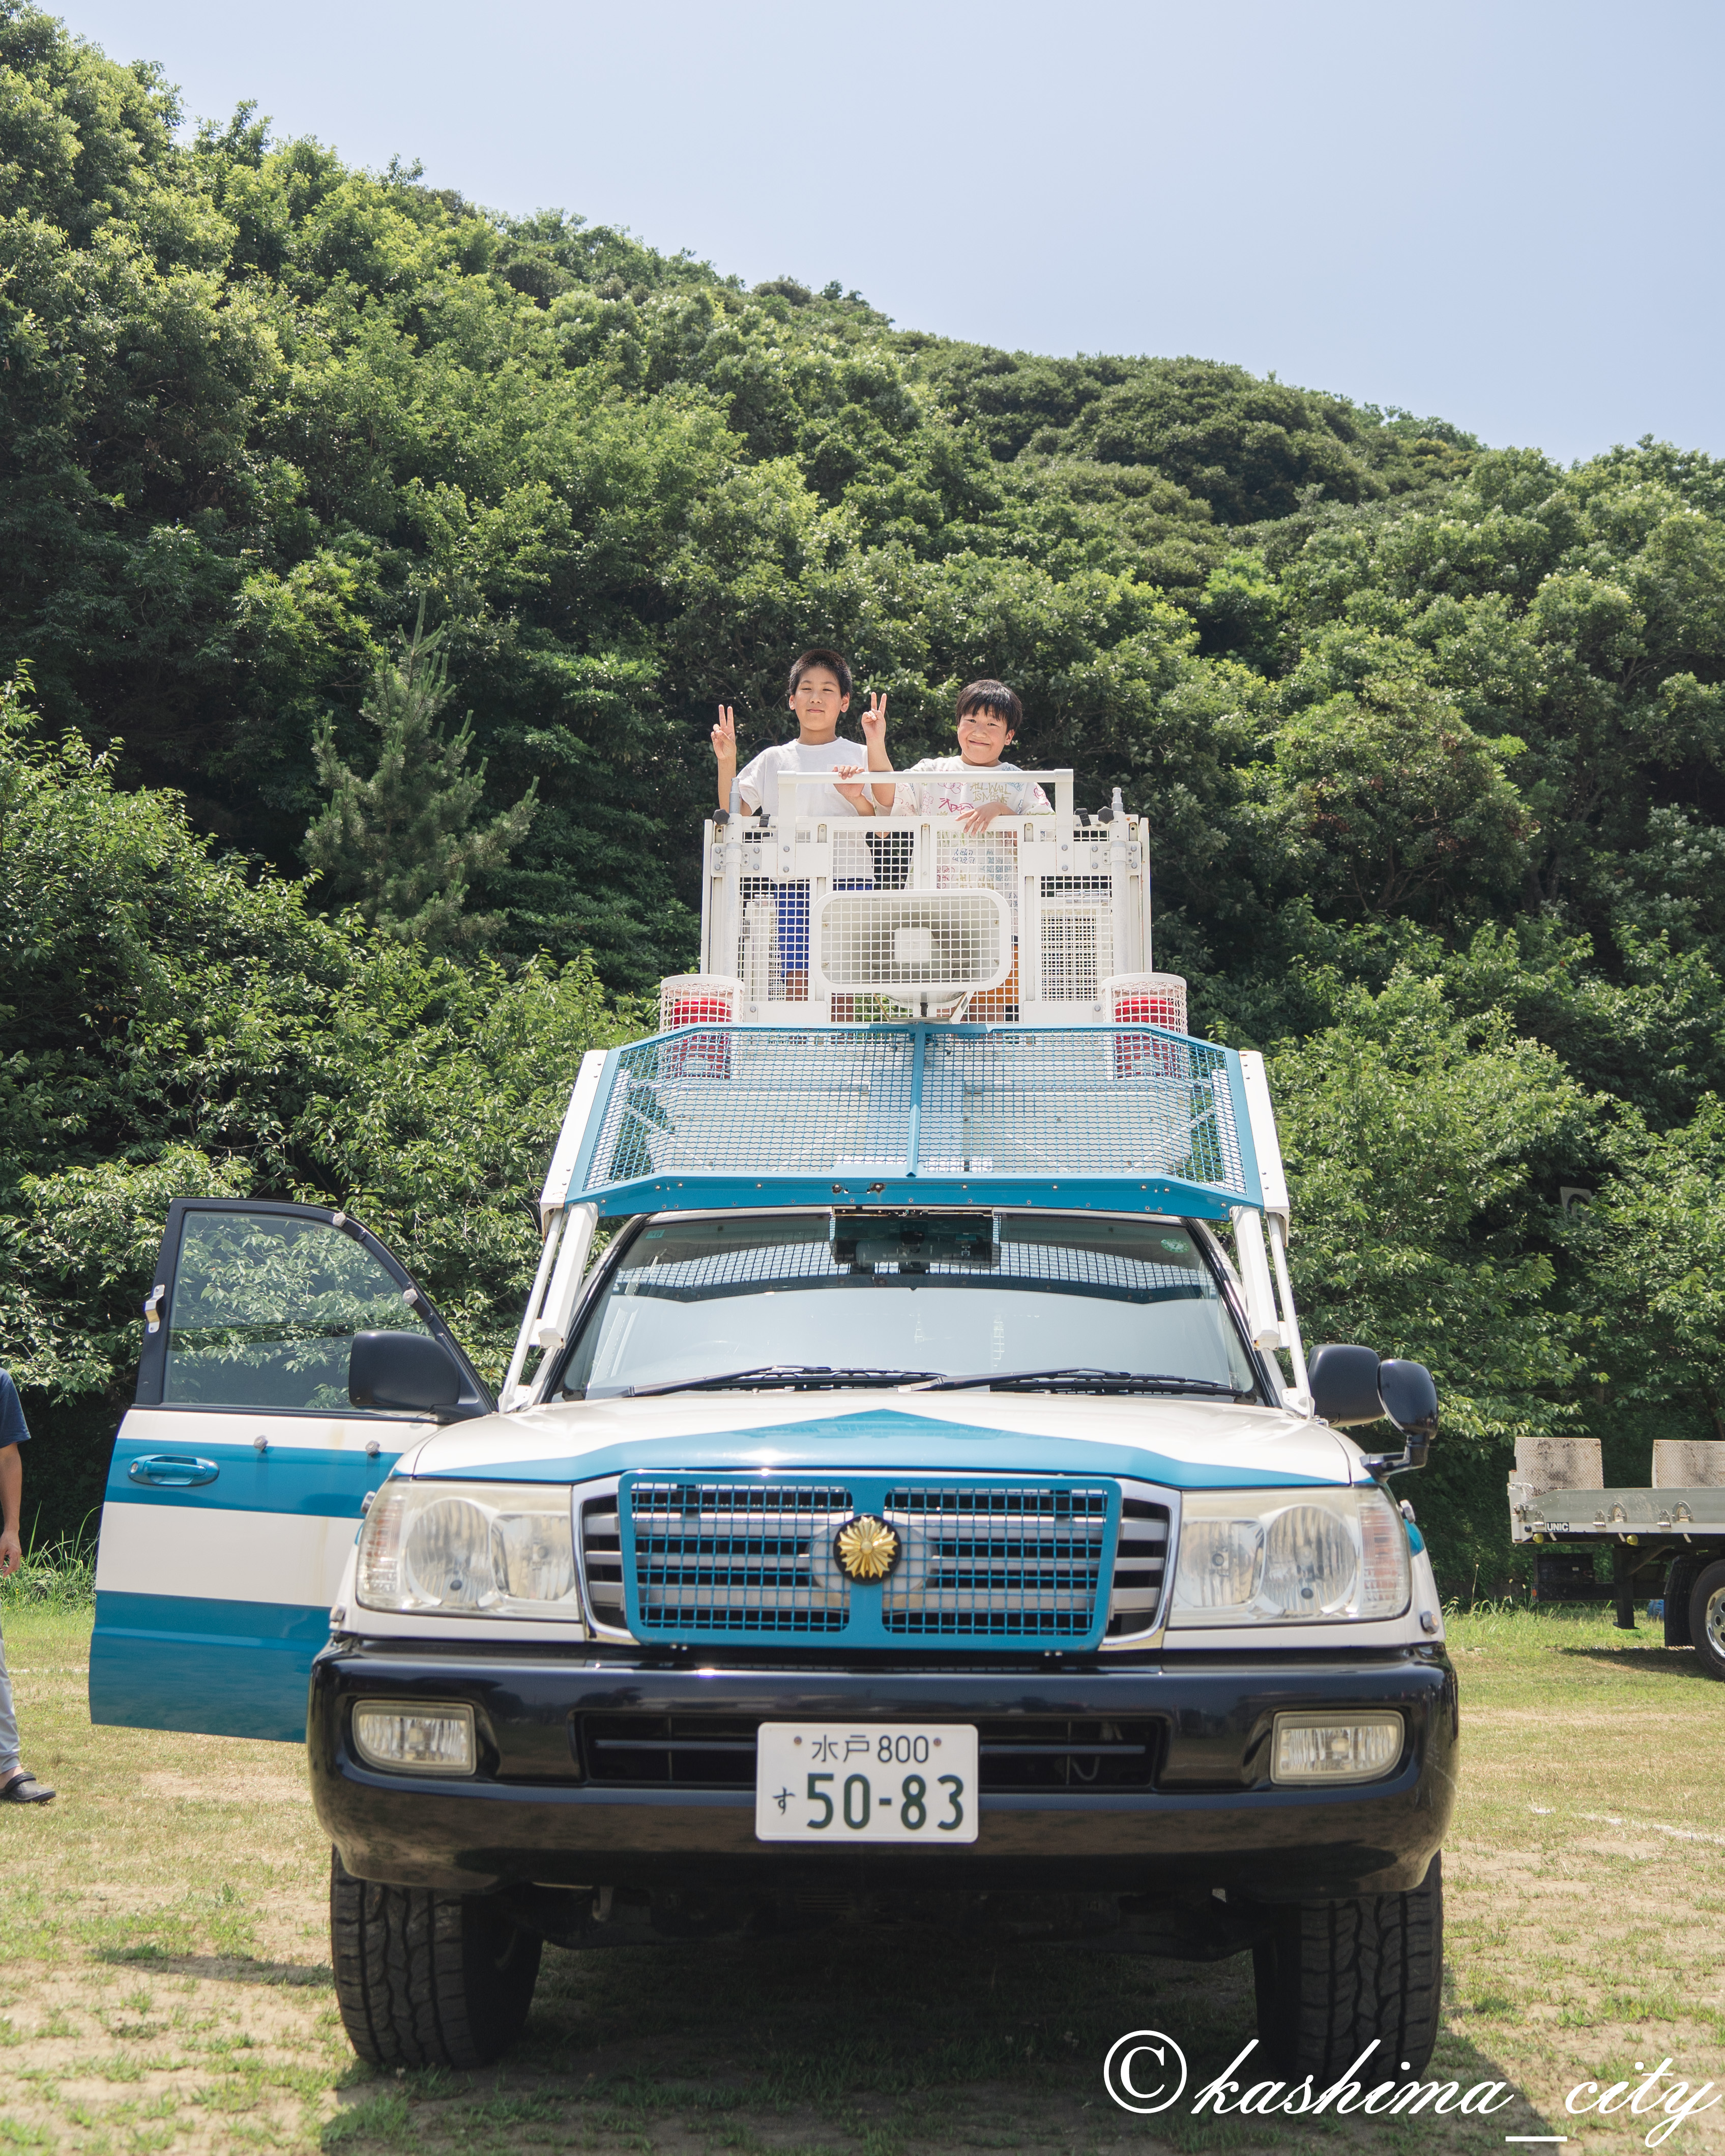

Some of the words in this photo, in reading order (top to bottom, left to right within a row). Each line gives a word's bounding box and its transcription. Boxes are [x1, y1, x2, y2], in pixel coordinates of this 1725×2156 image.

[988, 782, 1011, 794] WALL
[1546, 1523, 1569, 1531] UNIC
[772, 1787, 796, 1815] す
[806, 1773, 964, 1831] 50-83
